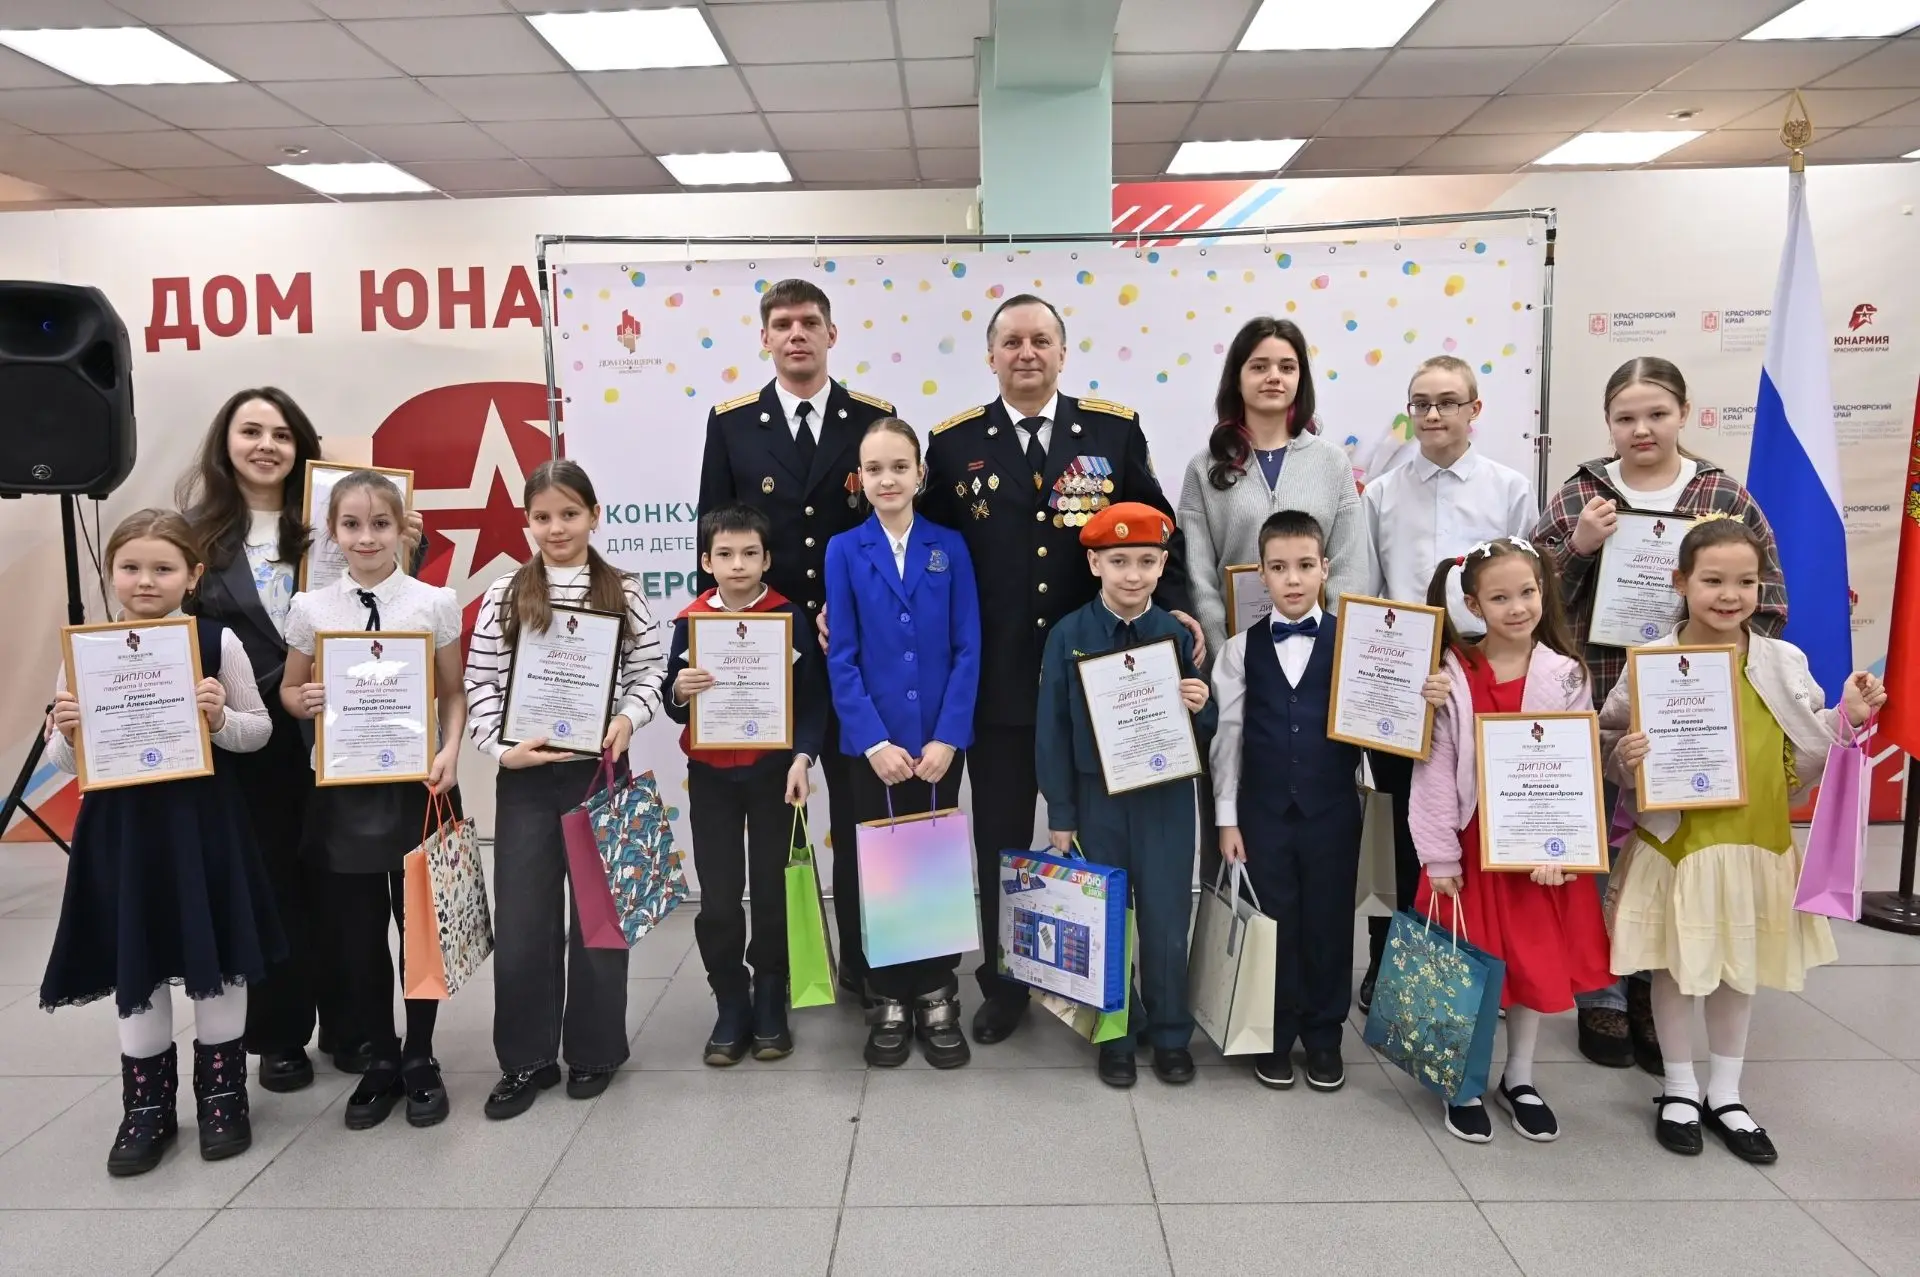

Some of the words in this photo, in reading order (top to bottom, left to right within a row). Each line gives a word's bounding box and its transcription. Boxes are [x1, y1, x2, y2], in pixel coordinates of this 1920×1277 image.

[145, 272, 313, 352] ДОМ
[360, 265, 558, 332] ЮНА
[1613, 311, 1676, 319] КРАСНОЯРСКИЙ
[1834, 335, 1890, 345] ЮНАРМИЯ
[607, 538, 644, 553] ДЛЯ
[1633, 554, 1674, 565] ДИПЛОМ
[547, 650, 587, 662] ДИПЛОМ
[1368, 645, 1405, 658] ДИПЛОМ
[723, 656, 761, 665] ДИПЛОМ
[112, 670, 161, 684] ДИПЛОМ
[355, 678, 398, 687] ДИПОМ
[123, 692, 156, 701] Грунина
[1118, 686, 1155, 702] ДИПЛОМ
[95, 703, 125, 713] Дарина
[126, 696, 185, 709] Александровна
[1667, 697, 1705, 707] ДИПЛОМ
[1680, 725, 1728, 733] Александровна
[1517, 762, 1562, 772] ДИПЛОМ
[1071, 872, 1101, 887] STUDIO
